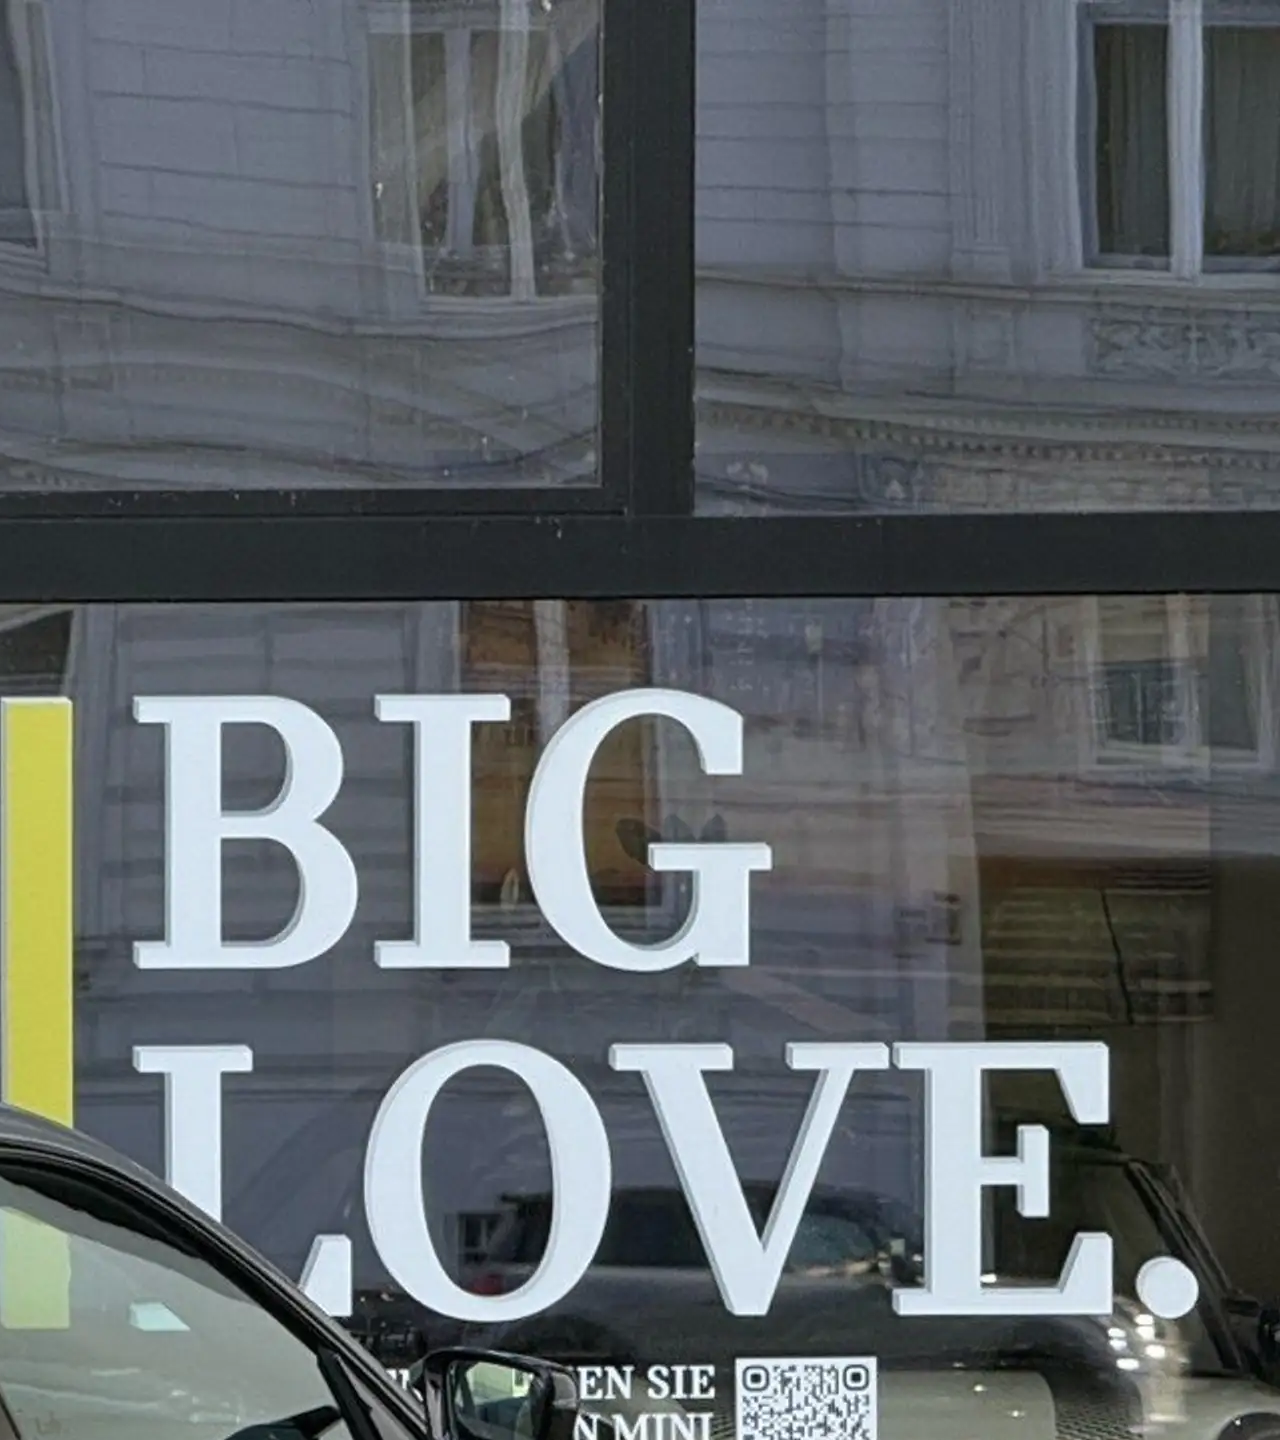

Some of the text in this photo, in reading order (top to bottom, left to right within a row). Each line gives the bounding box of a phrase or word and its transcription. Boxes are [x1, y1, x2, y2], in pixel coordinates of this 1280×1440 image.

[133, 687, 773, 972] BIG
[133, 1038, 1199, 1323] LOVE.
[647, 1365, 716, 1400] SIE
